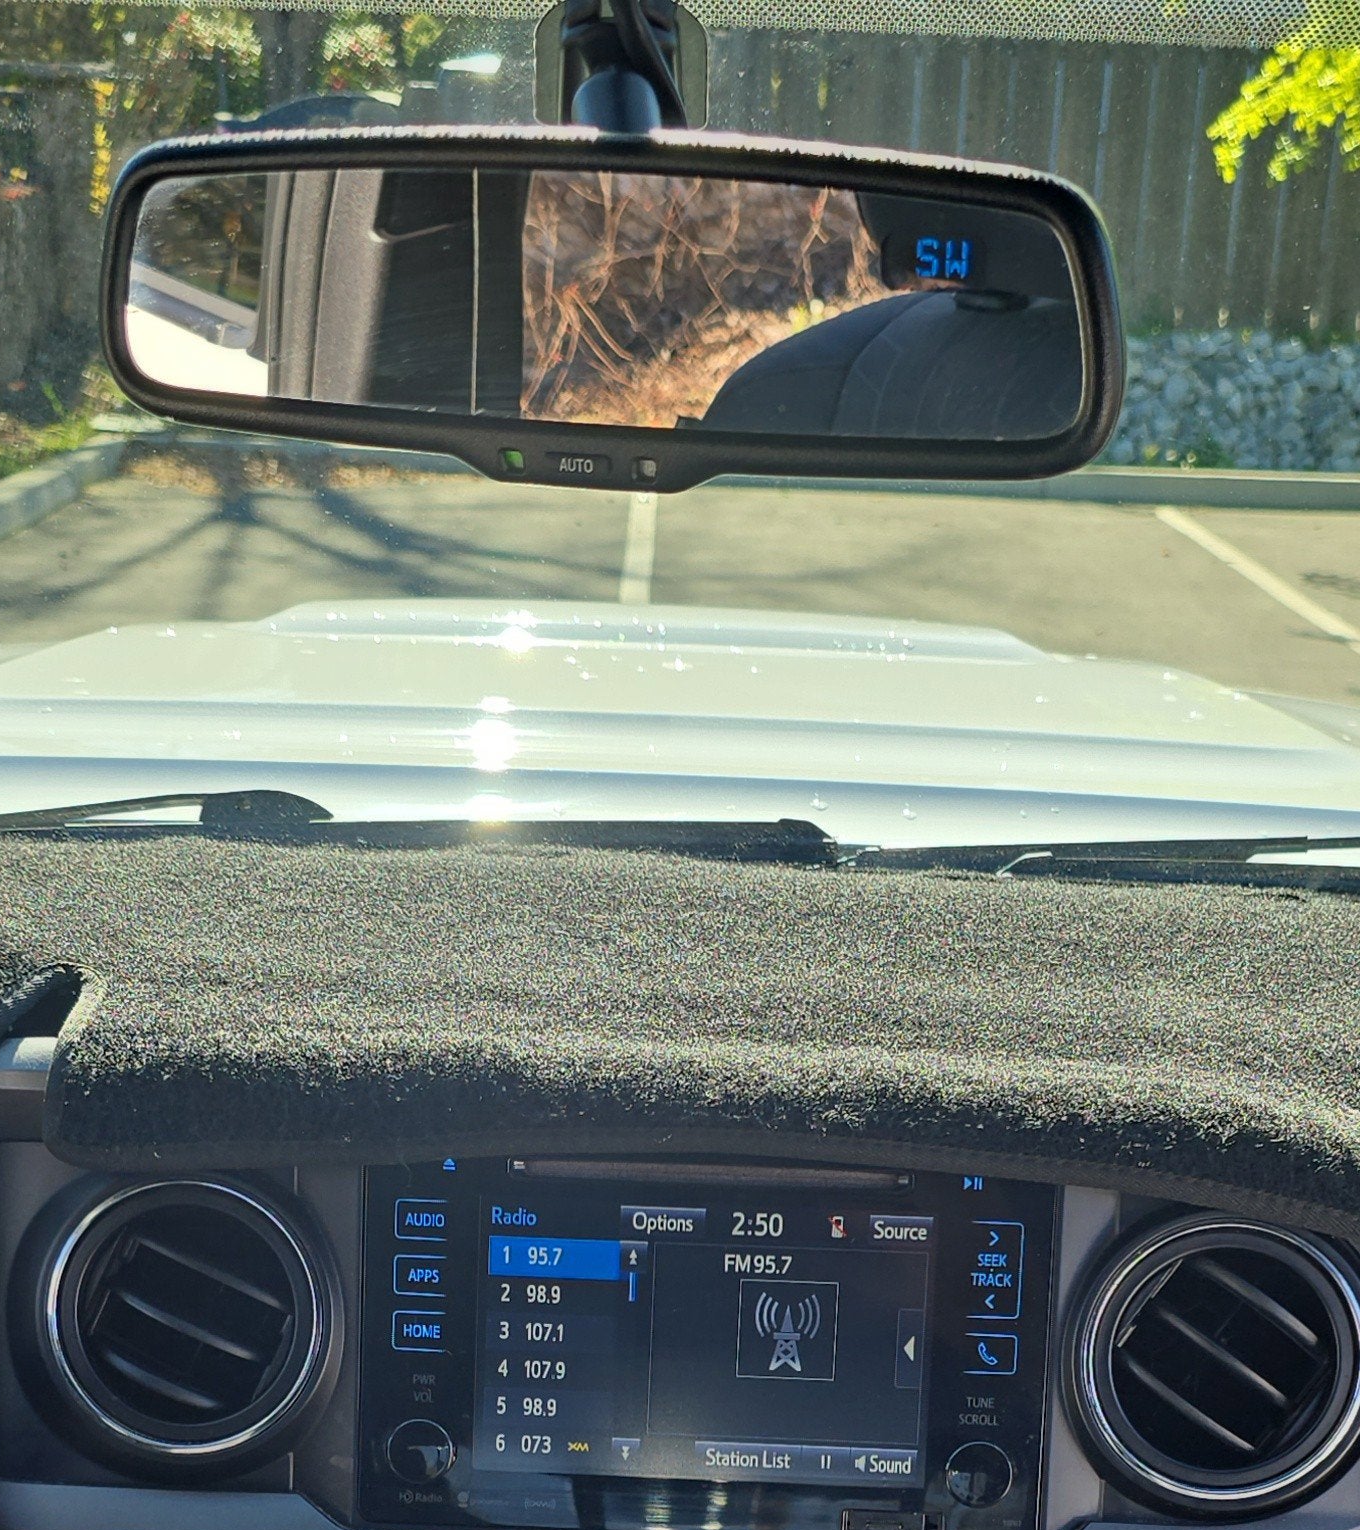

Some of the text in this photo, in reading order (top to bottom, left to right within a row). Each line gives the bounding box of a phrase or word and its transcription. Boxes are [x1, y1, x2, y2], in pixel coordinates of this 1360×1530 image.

[916, 238, 970, 279] SW
[558, 457, 594, 475] AUTO
[405, 1212, 445, 1228] AUDIO
[491, 1206, 537, 1226] Radio
[632, 1211, 694, 1235] Options
[731, 1212, 784, 1237] 2:50
[873, 1220, 928, 1241] Source
[502, 1245, 563, 1266] 1 95.7
[977, 1253, 1008, 1267] SEEK
[407, 1268, 439, 1283] APPS
[970, 1272, 1012, 1288] TRACK
[500, 1283, 562, 1304] 2 98.9
[403, 1323, 441, 1339] HOME
[499, 1321, 564, 1342] 3 107.1
[413, 1373, 436, 1385] PWR
[497, 1358, 566, 1380] 4 107.9
[413, 1390, 434, 1403] VOL
[496, 1396, 557, 1417] 5 98.9
[966, 1396, 995, 1409] TUNE
[958, 1413, 1000, 1426] SCROLL
[495, 1433, 506, 1452] 6
[521, 1434, 552, 1454] 073
[705, 1448, 791, 1469] Station List
[869, 1455, 912, 1475] Sound
